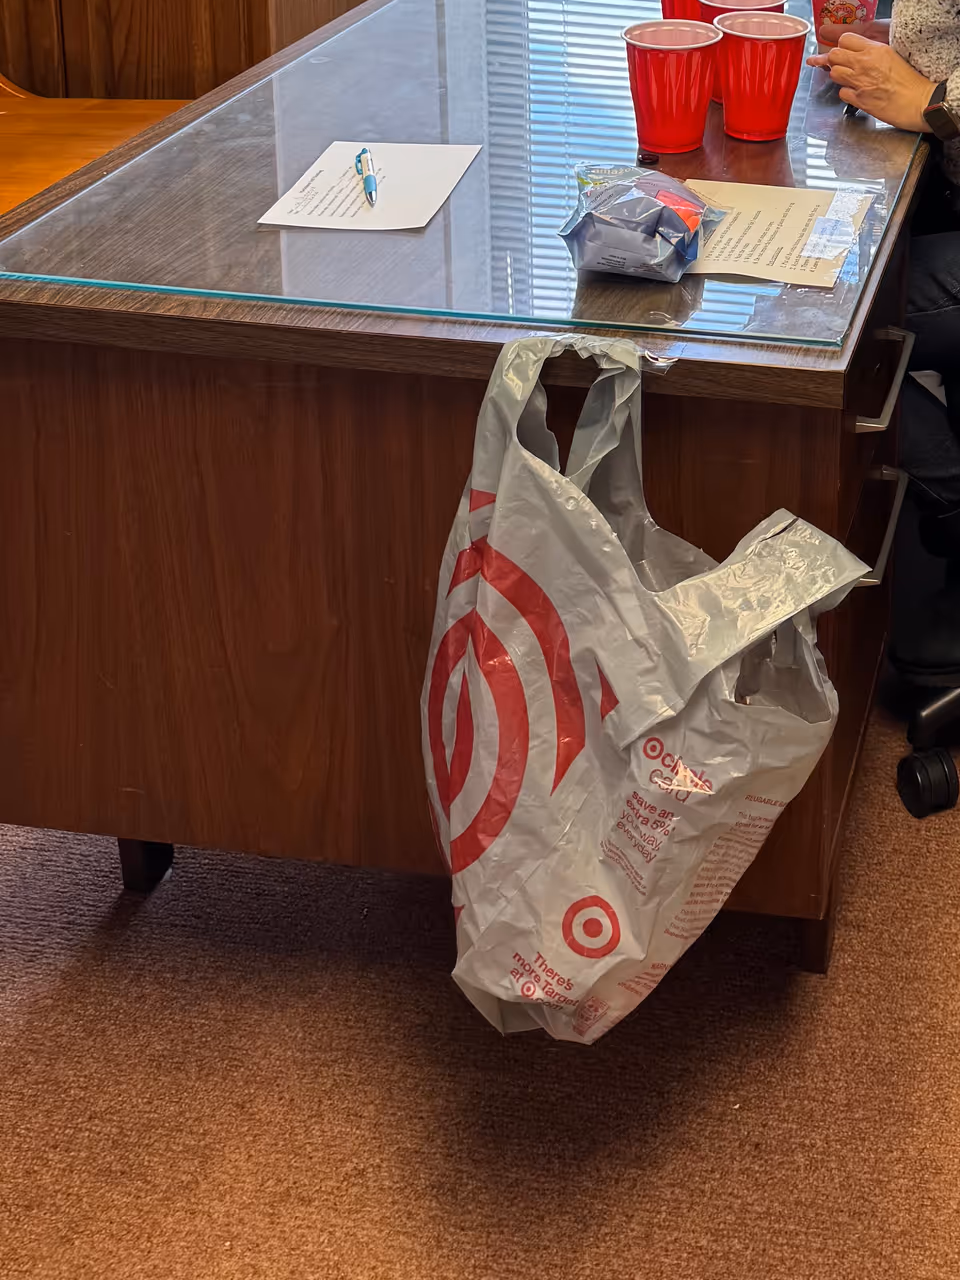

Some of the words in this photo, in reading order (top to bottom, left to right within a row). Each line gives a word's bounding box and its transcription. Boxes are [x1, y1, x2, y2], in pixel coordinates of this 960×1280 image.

[649, 769, 694, 804] cad
[661, 753, 713, 793] cicle
[626, 800, 649, 826] extra
[632, 791, 657, 814] save
[617, 821, 657, 864] everyday
[510, 967, 525, 983] at
[513, 952, 541, 983] more
[542, 980, 580, 1006] Target
[534, 951, 574, 991] There's
